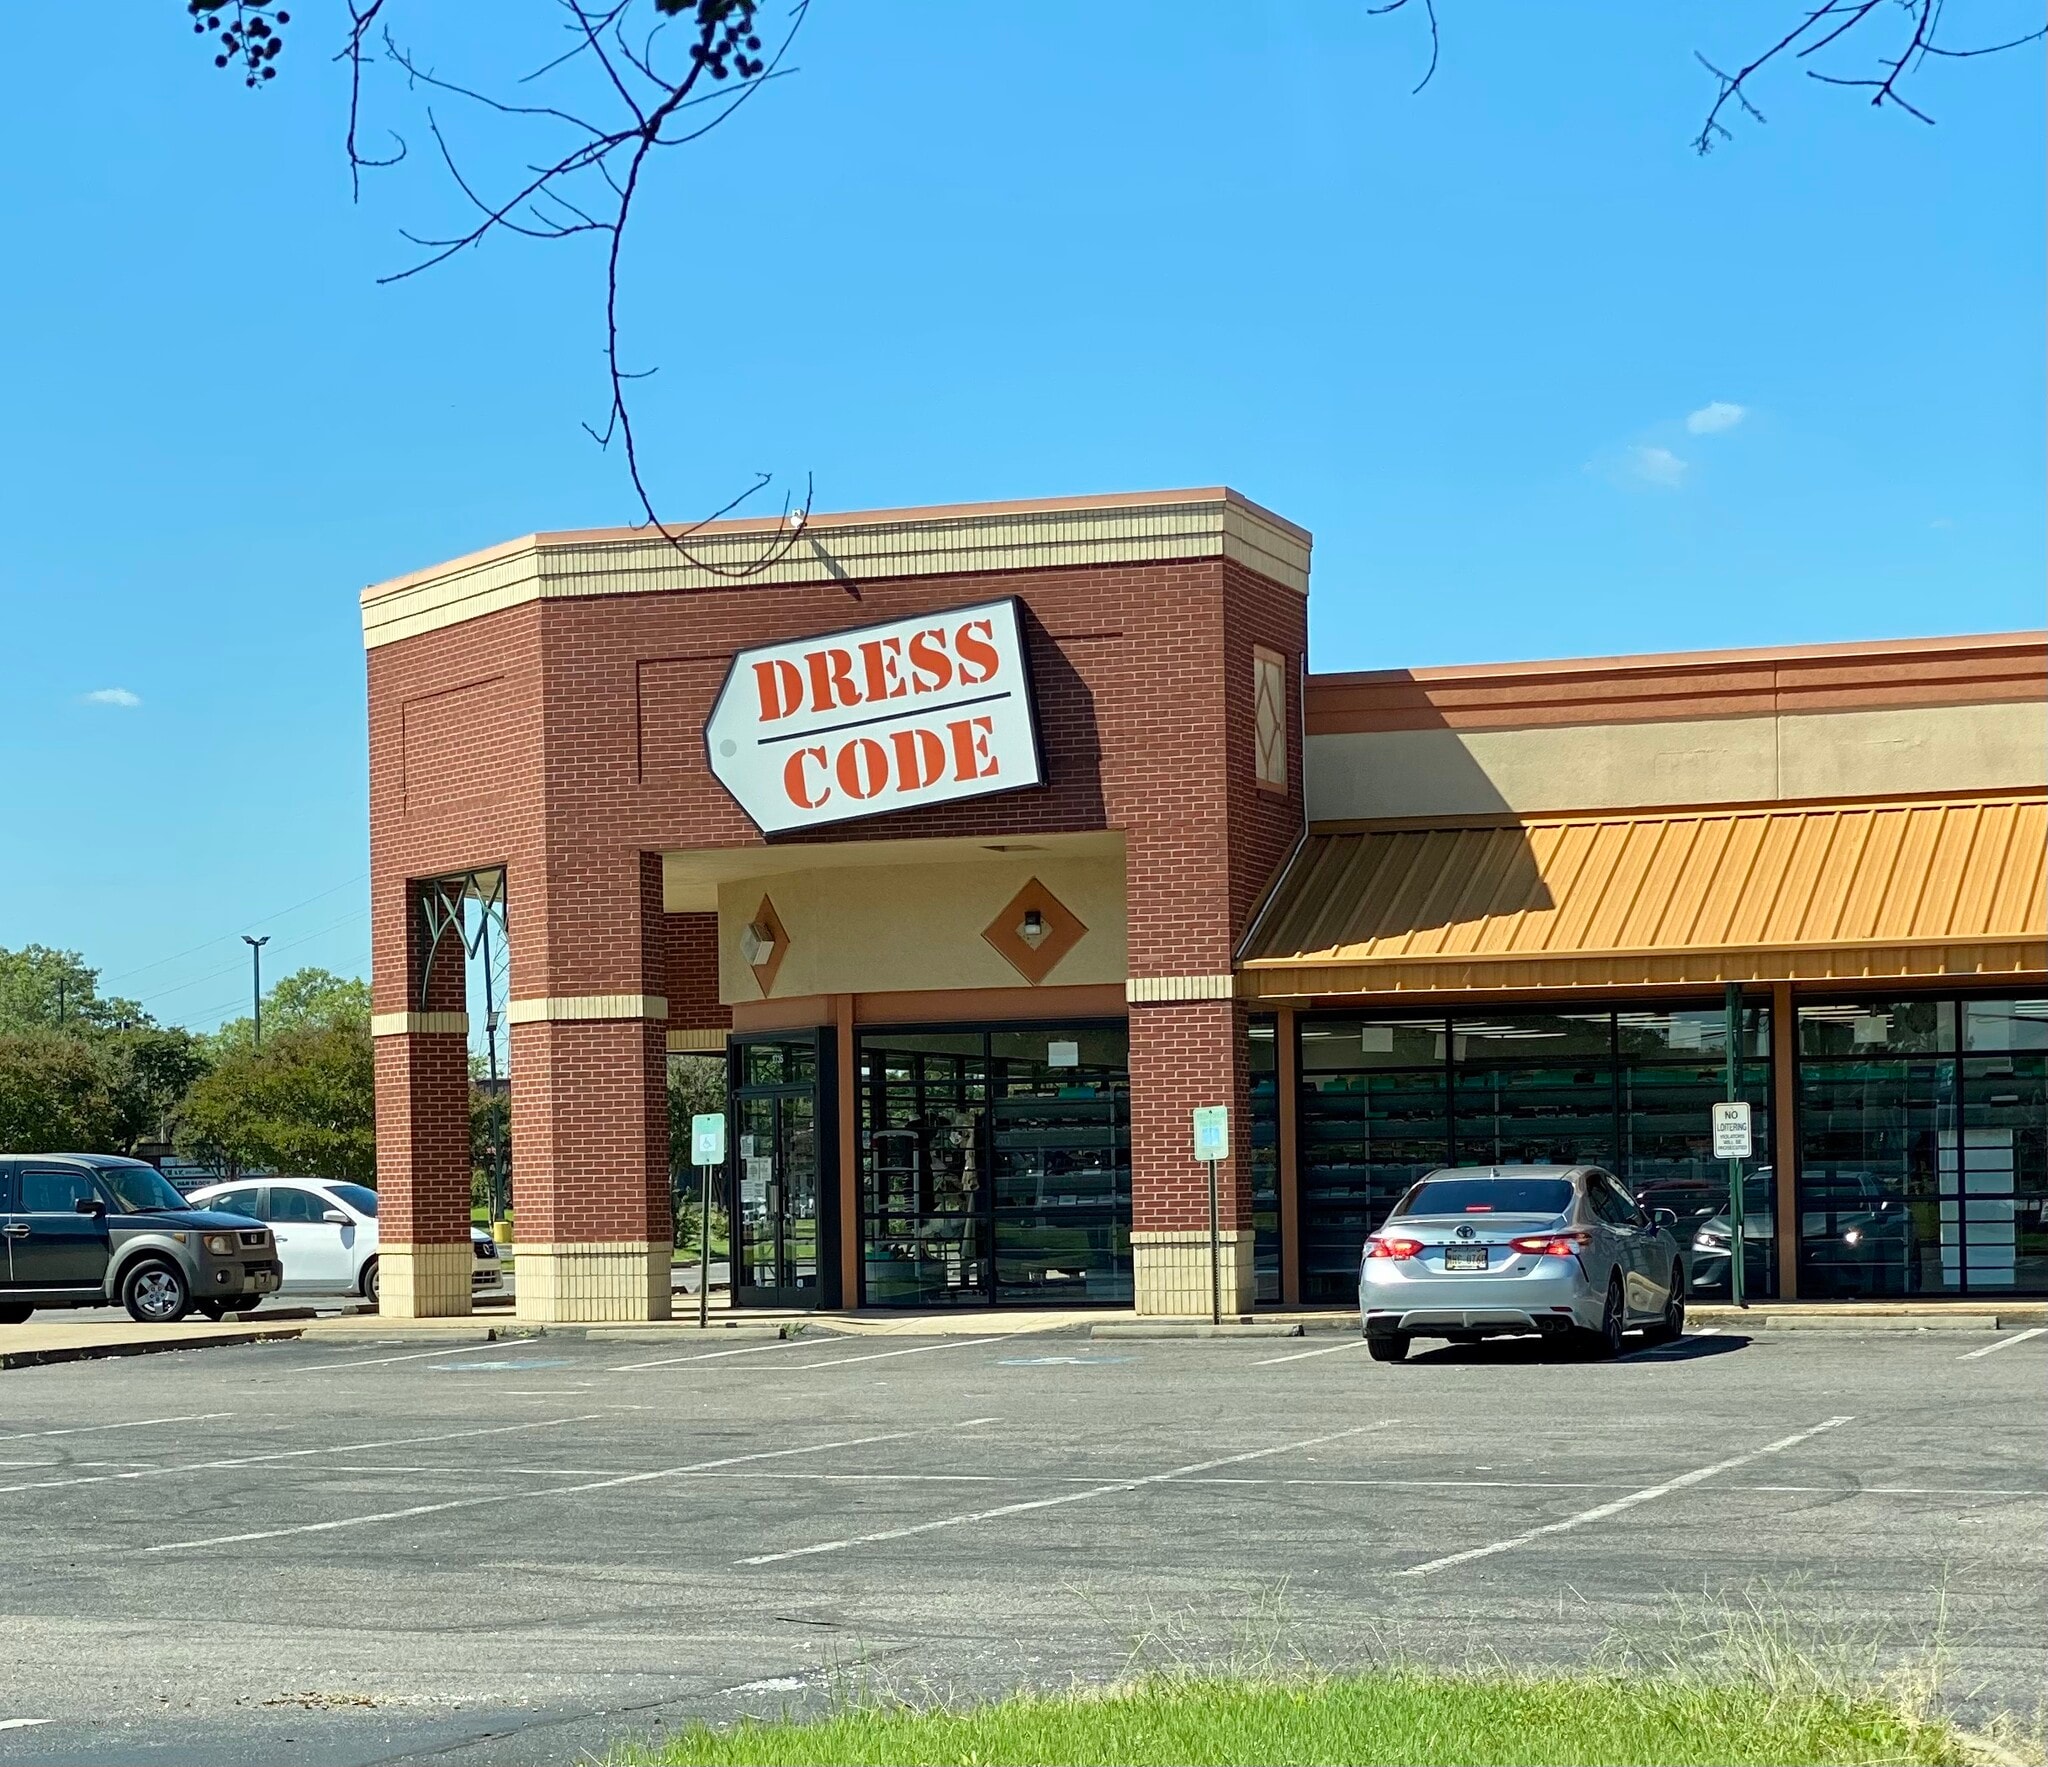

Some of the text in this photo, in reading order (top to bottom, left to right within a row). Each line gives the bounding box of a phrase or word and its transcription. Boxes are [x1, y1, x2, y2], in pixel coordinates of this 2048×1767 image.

[752, 619, 1000, 722] DRESS
[783, 716, 1000, 809] CODE
[1717, 1123, 1747, 1131] LOITERING
[1724, 1111, 1738, 1119] NO
